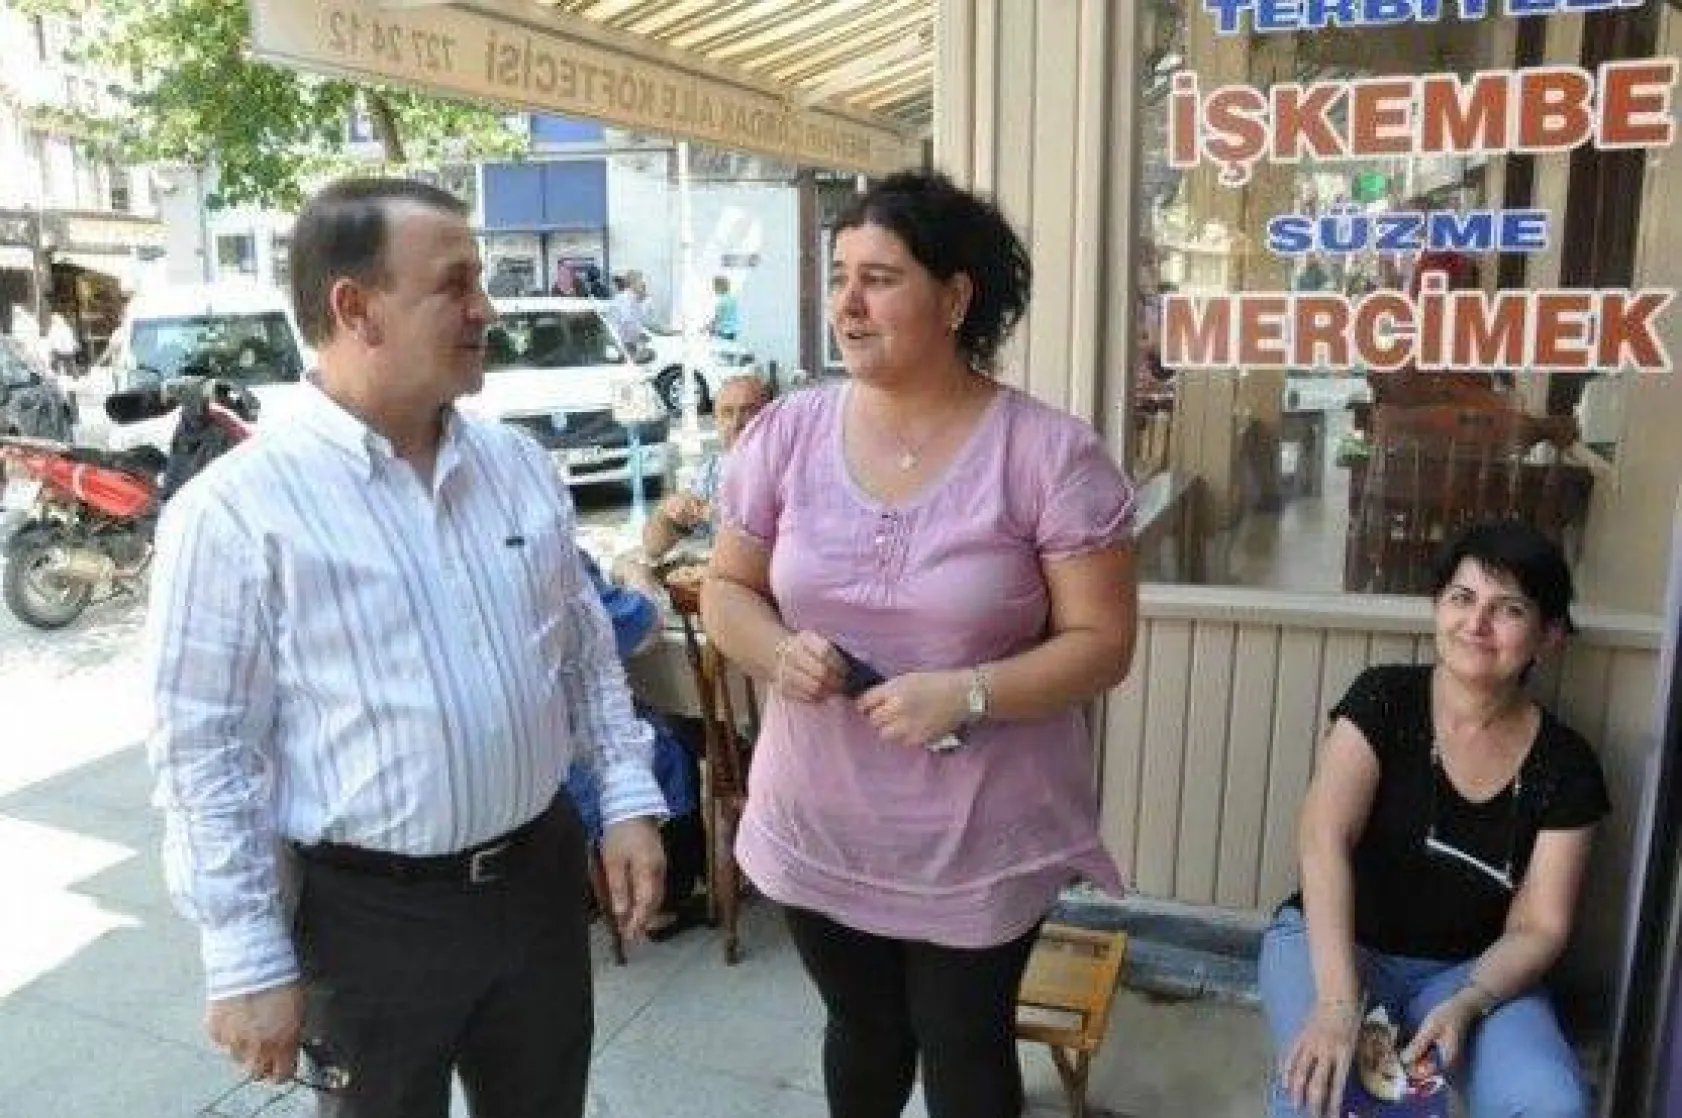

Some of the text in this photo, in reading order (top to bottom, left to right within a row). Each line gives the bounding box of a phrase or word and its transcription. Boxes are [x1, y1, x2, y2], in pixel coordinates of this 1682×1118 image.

[1168, 57, 1680, 187] İŞKEMBE
[1267, 204, 1551, 254] SÜZME
[1160, 269, 1674, 372] MERCİMEK
